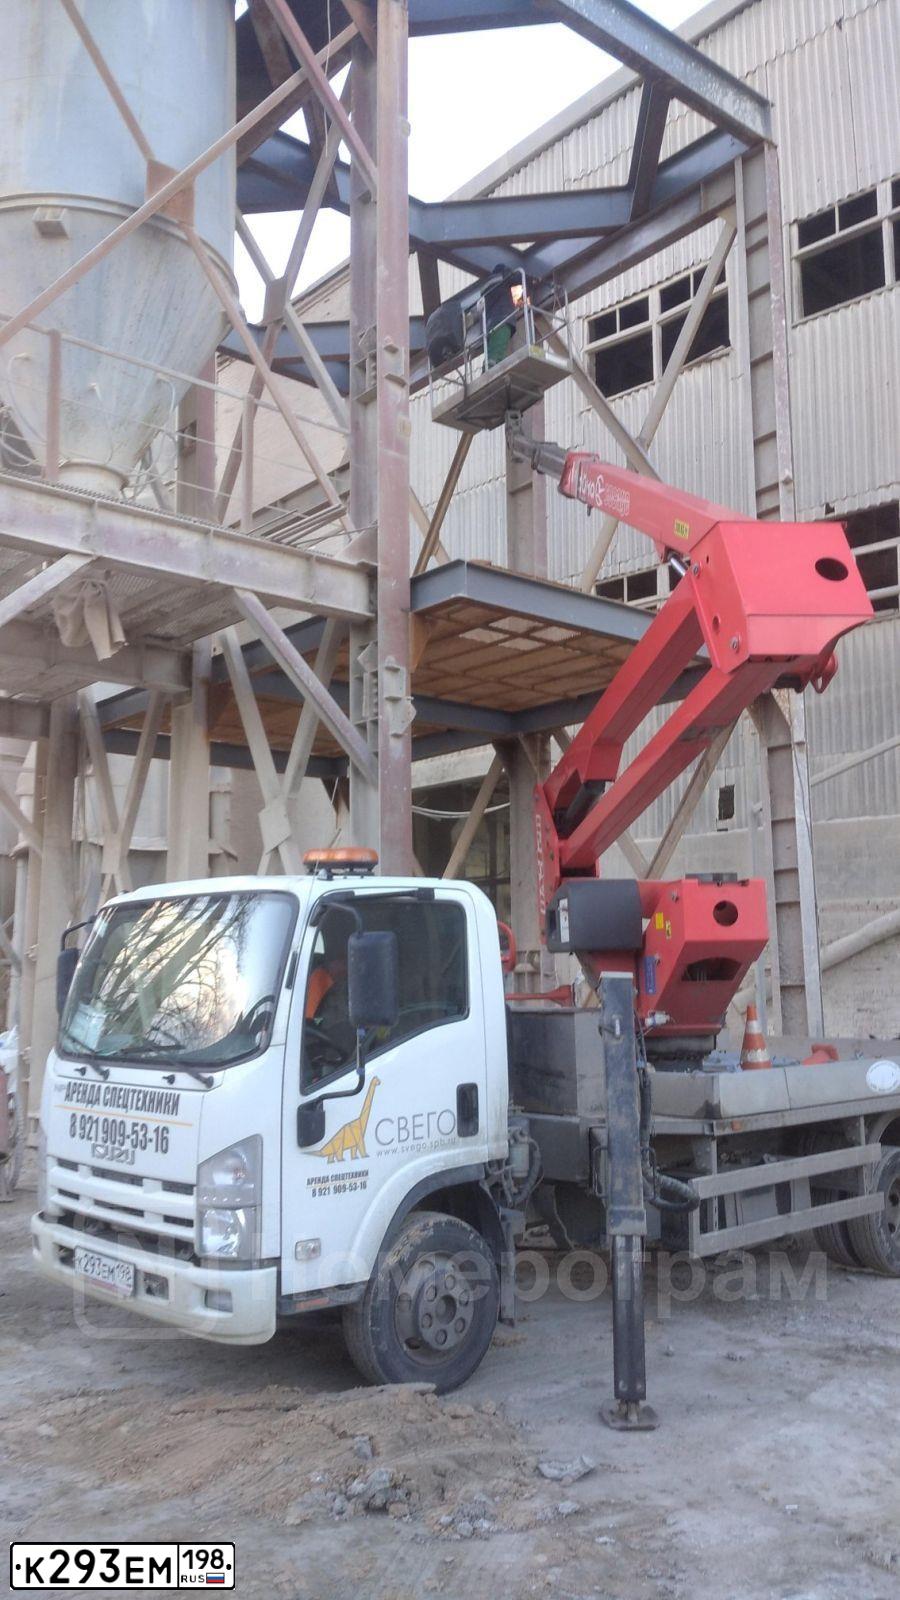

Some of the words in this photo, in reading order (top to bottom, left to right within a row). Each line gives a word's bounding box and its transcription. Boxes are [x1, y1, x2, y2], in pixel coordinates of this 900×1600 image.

[64, 1081, 102, 1108] АРЕНДА
[103, 1085, 181, 1116] СПЕЦТЕХНИКИ
[69, 1112, 77, 1138] 8
[79, 1114, 99, 1142] 921
[102, 1117, 170, 1154] 909-53-16
[375, 1109, 456, 1146] СВЕГО
